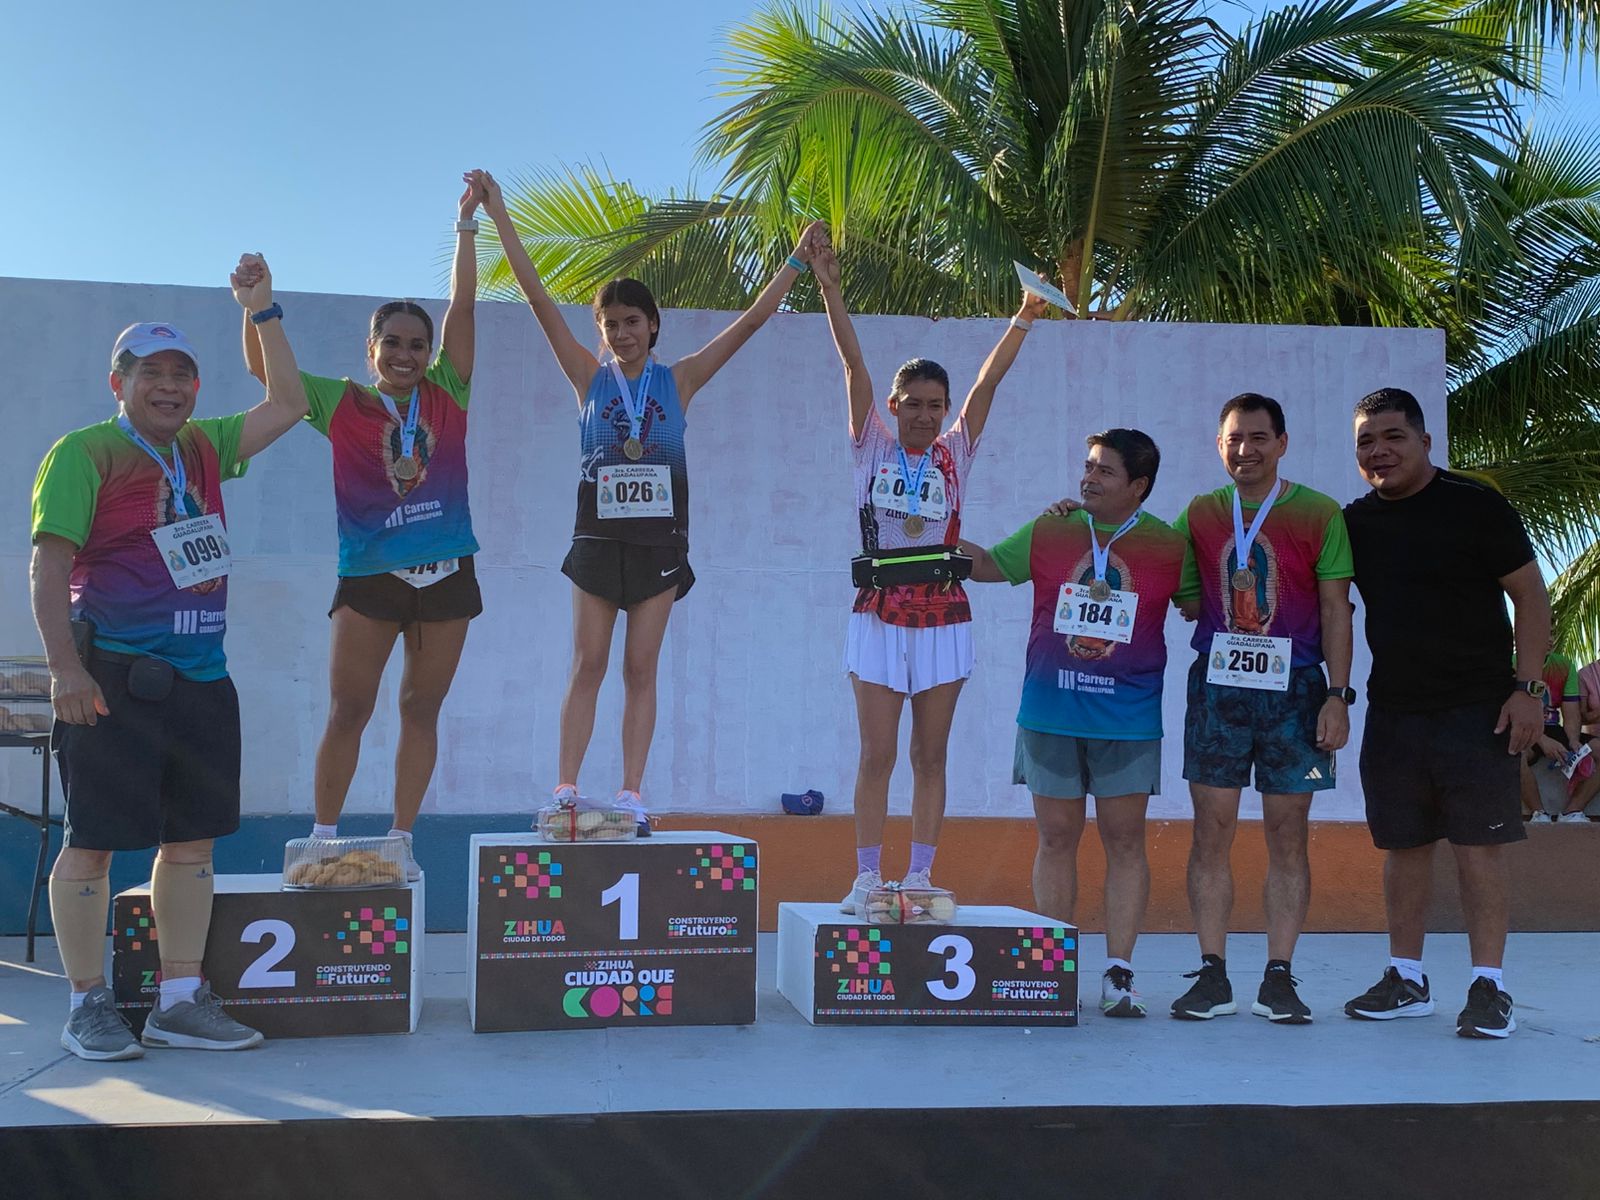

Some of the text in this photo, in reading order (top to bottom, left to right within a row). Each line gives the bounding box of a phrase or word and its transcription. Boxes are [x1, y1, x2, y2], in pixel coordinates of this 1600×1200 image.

[615, 481, 653, 503] 026
[893, 478, 930, 502] 04
[404, 500, 441, 515] Carrera
[182, 534, 222, 566] 099
[1078, 602, 1114, 626] 184
[1226, 640, 1276, 649] GUADALUPANA
[1228, 649, 1269, 674] 250
[1077, 672, 1115, 686] Carrera
[601, 872, 640, 940] 1
[503, 919, 566, 936] ZIHUA
[668, 916, 738, 925] CONSTRUYENDO
[679, 924, 728, 936] Futuro
[238, 918, 296, 989] 2
[316, 963, 392, 973] CONSTRUYENDO
[597, 959, 634, 970] ZIHUA
[926, 934, 977, 1001] 3
[328, 972, 380, 985] Futuro
[564, 969, 675, 986] CIUDAD QUE
[991, 980, 1059, 988] CONSTRUYENDO
[837, 978, 896, 994] ZIHUA
[1003, 987, 1049, 1000] Futuro
